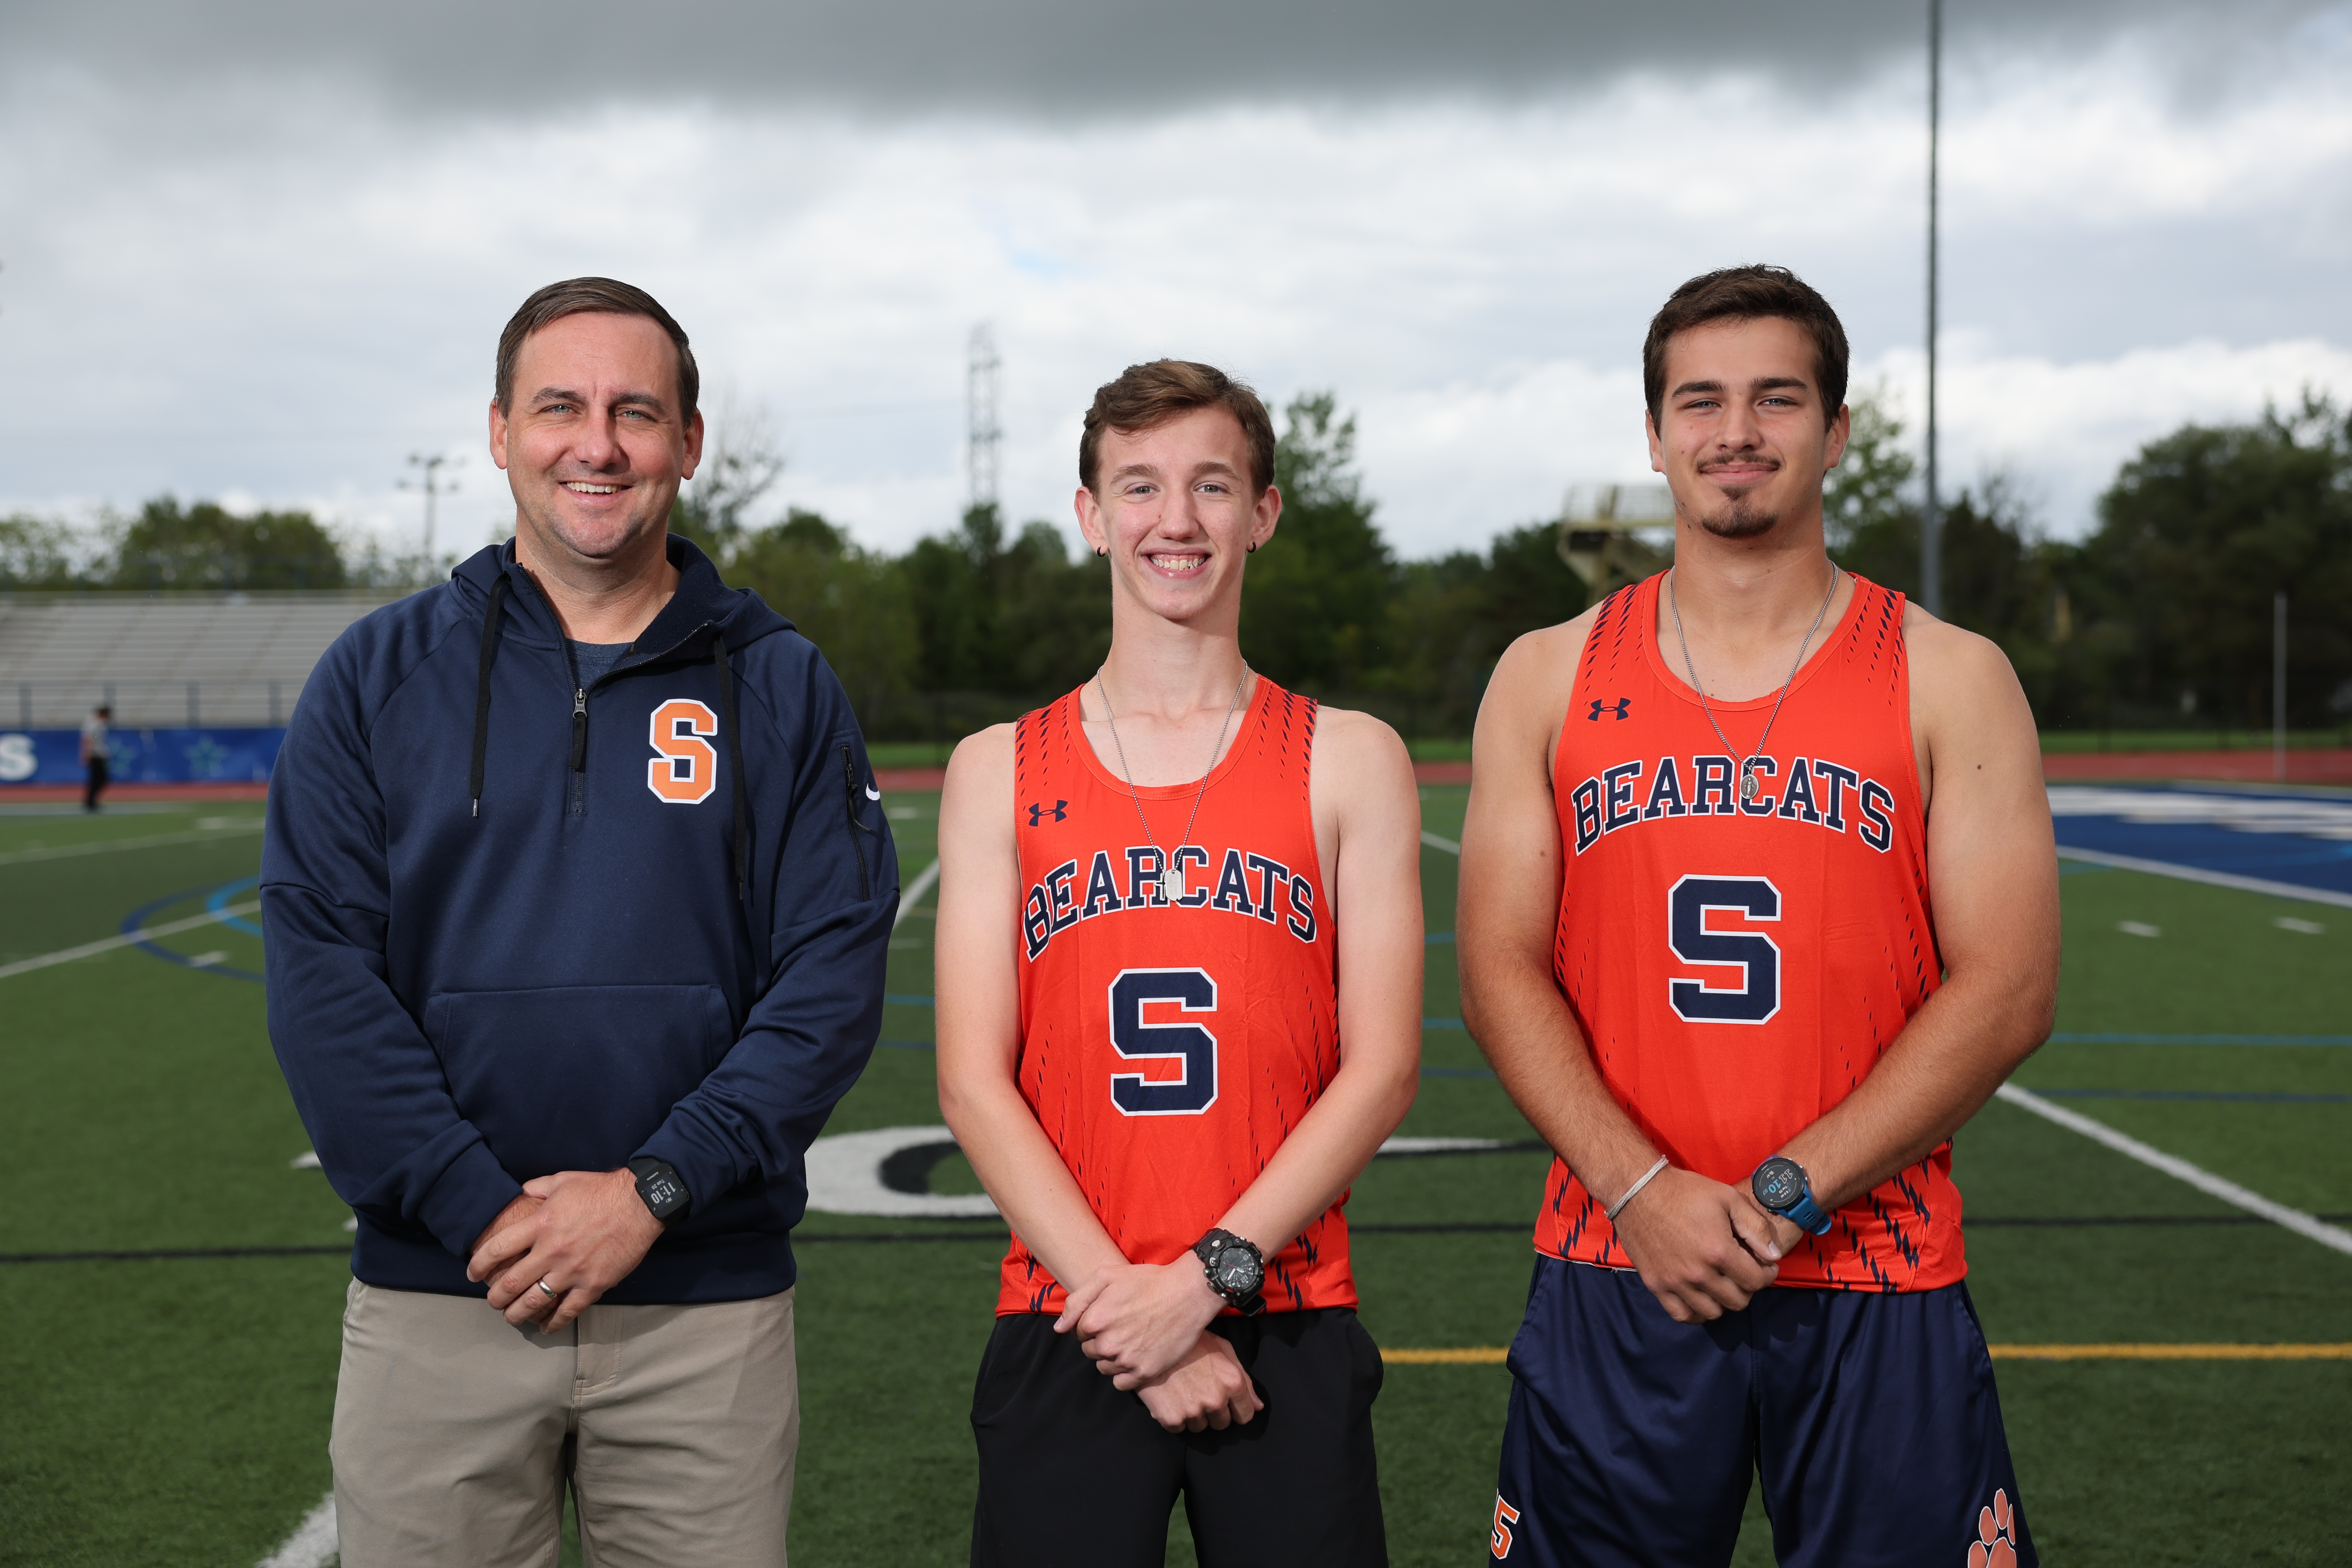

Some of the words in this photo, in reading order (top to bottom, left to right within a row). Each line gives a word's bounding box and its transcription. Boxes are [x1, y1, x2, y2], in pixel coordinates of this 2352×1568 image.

[648, 699, 717, 804] S
[1570, 755, 1894, 856] BEARCATS
[1022, 845, 1317, 963] BEARCATS
[1668, 874, 1781, 1025] S
[1108, 967, 1218, 1116] S
[647, 1172, 659, 1181] GARMIN
[651, 1182, 676, 1204] 11:10
[1779, 1169, 1793, 1184] 11
[1240, 1275, 1248, 1283] 12
[1243, 1277, 1259, 1294] G-SHOCK
[1491, 1488, 1521, 1560] 5
